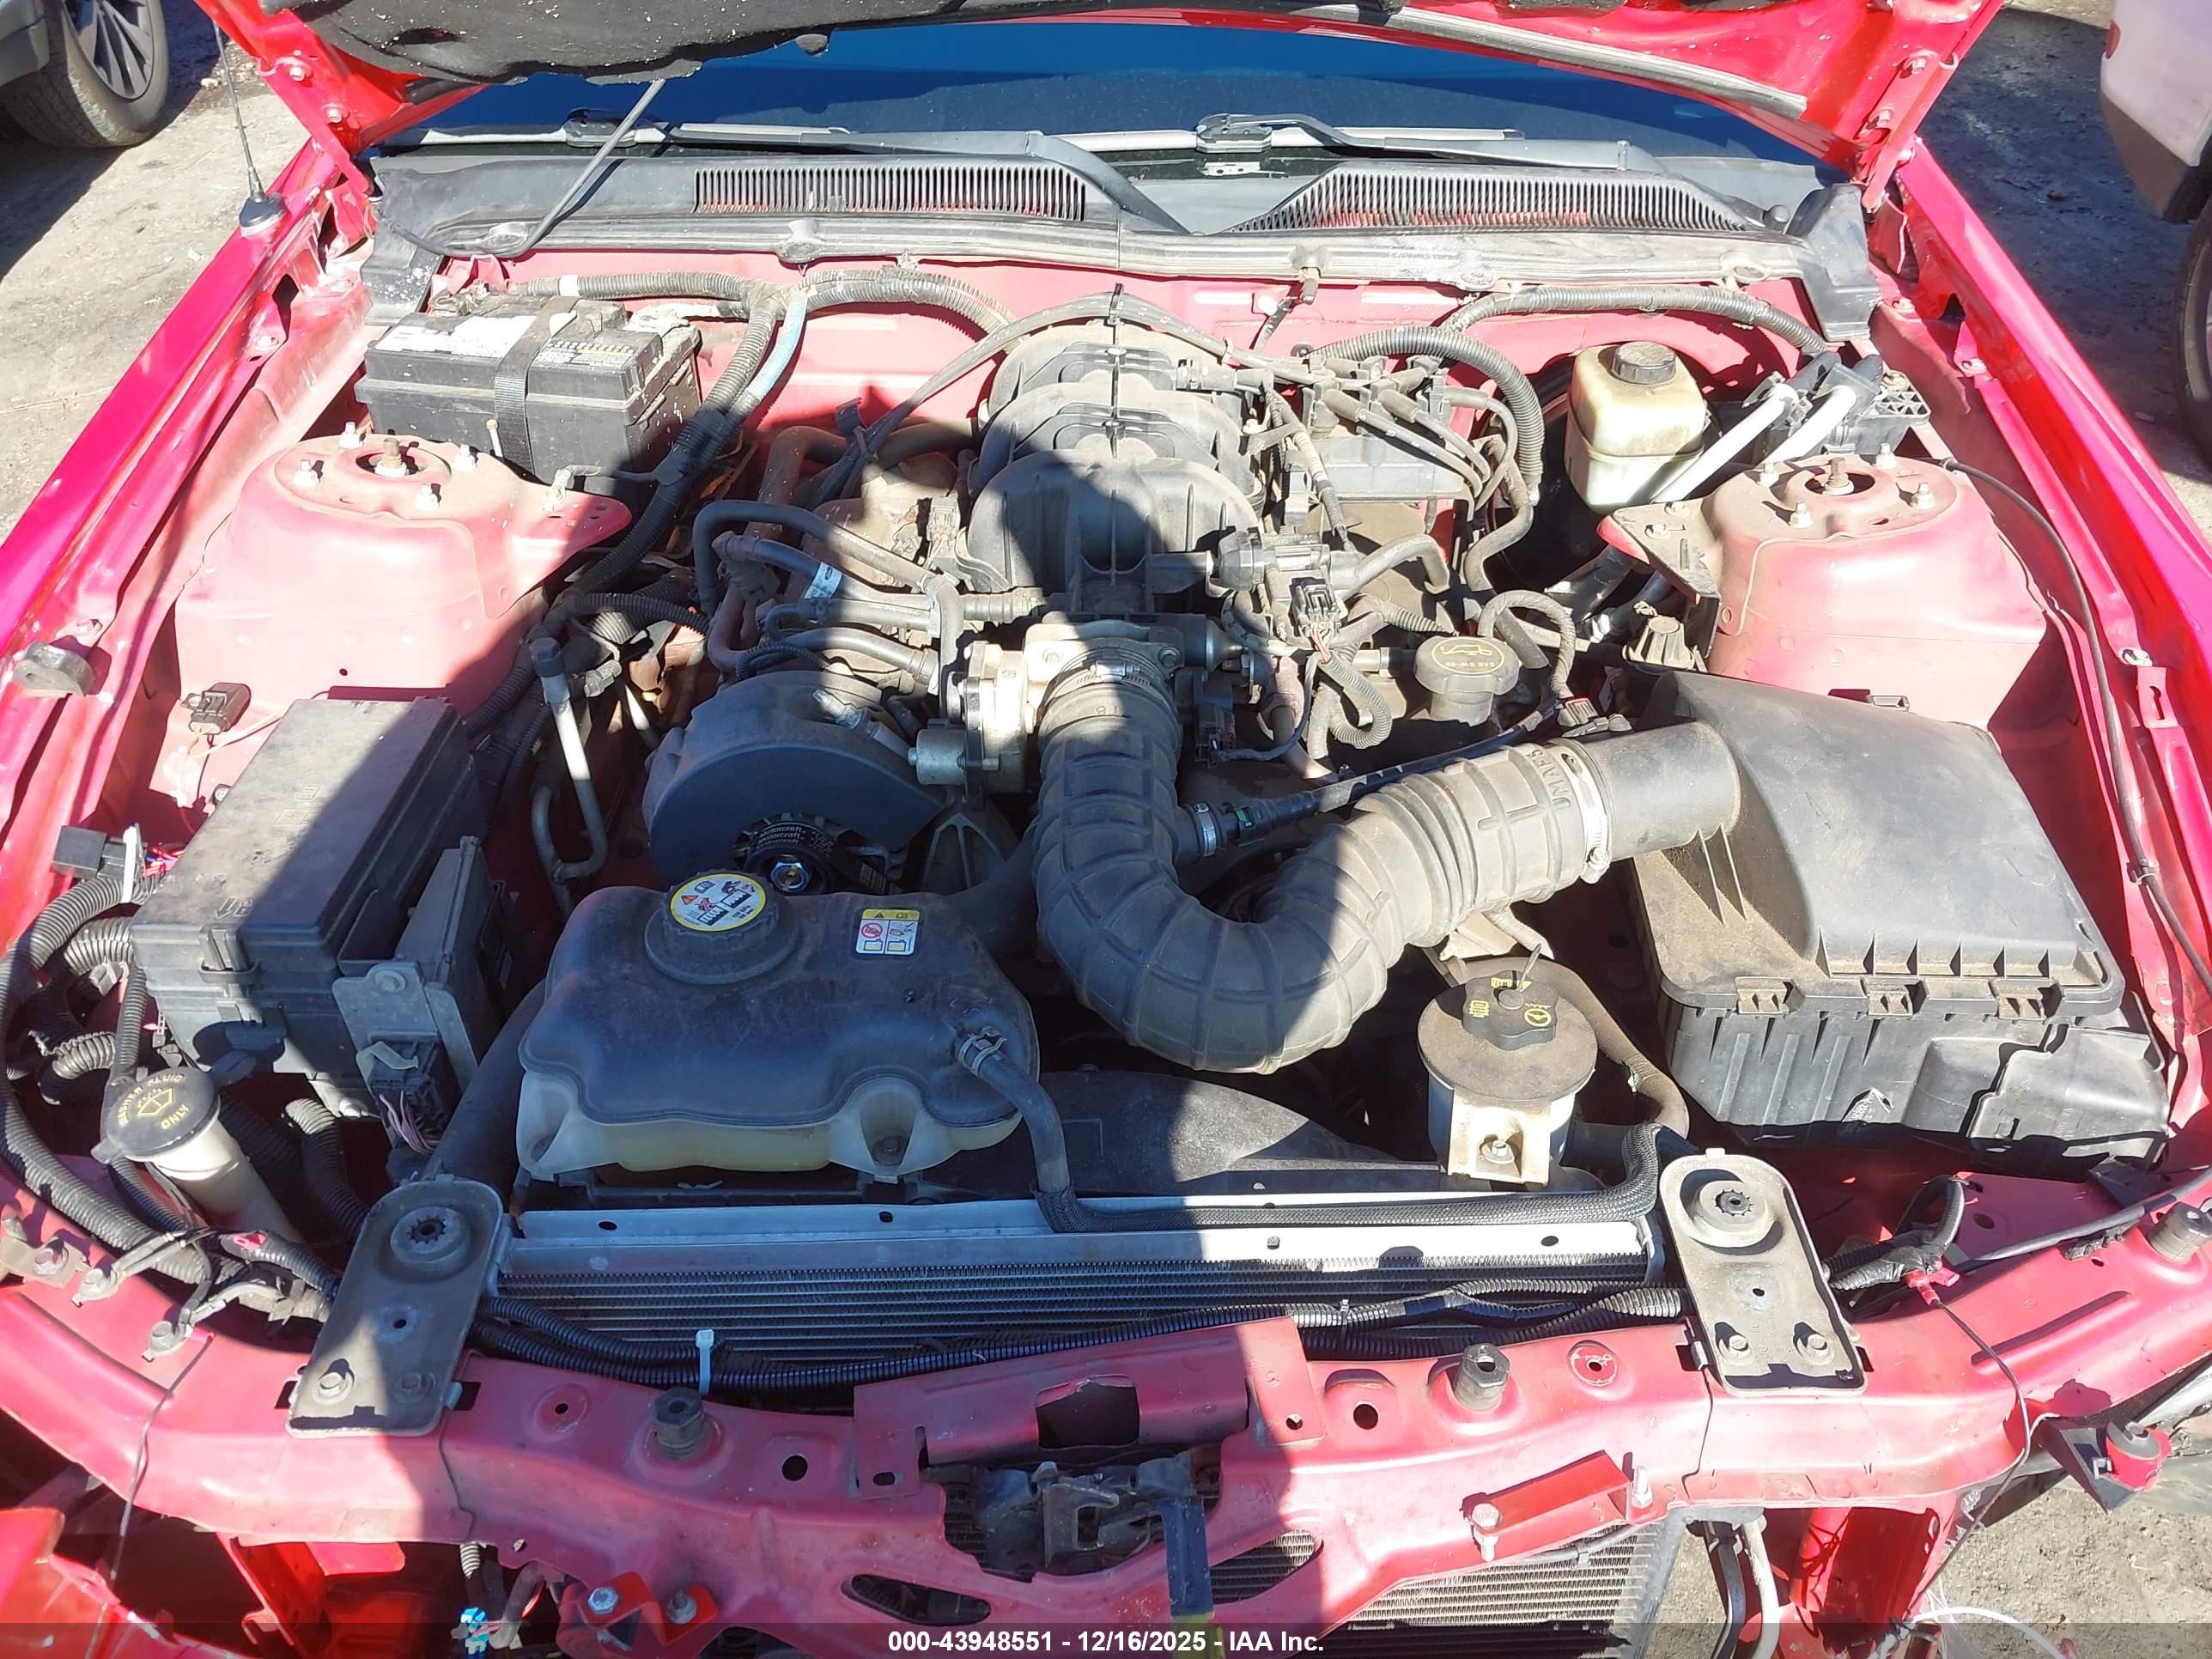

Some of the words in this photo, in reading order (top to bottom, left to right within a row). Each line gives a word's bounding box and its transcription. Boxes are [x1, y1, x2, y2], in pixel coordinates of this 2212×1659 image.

[758, 826, 803, 837] Motorcraft
[757, 833, 802, 844] Motorcraft
[148, 1073, 185, 1086] FLUID
[161, 1104, 189, 1130] ONLY
